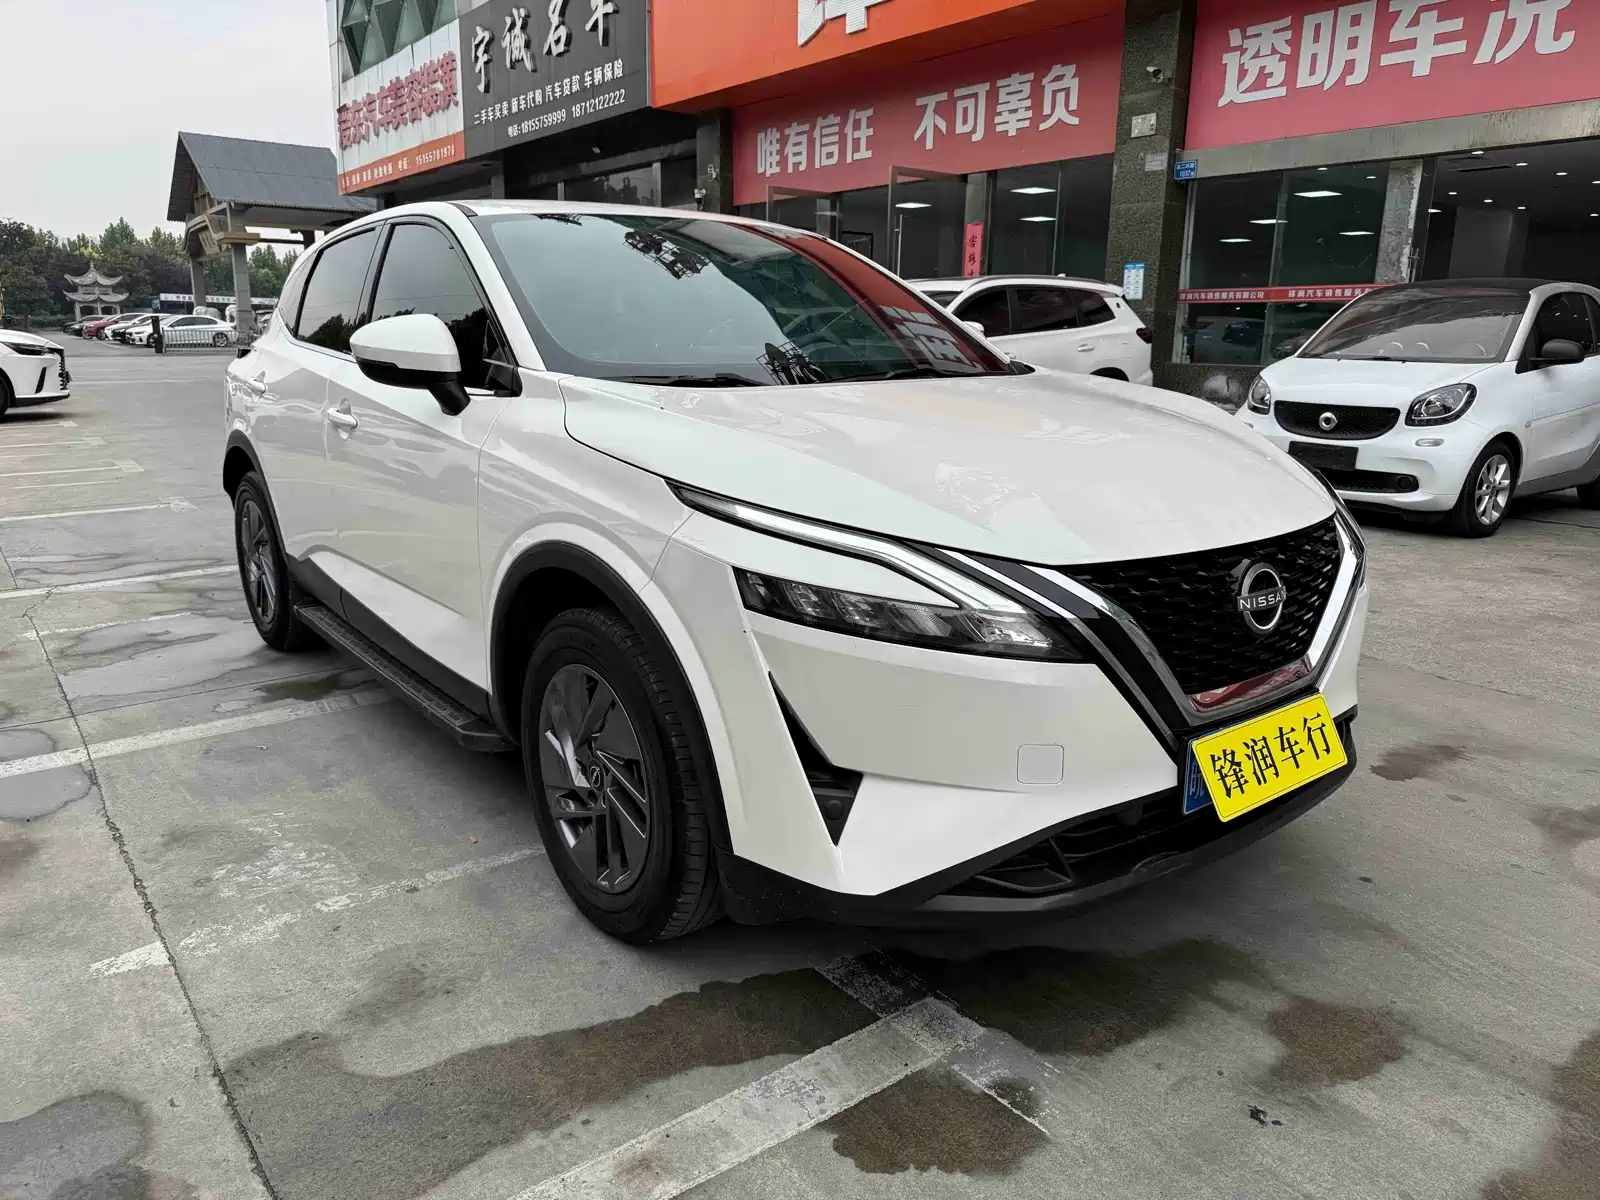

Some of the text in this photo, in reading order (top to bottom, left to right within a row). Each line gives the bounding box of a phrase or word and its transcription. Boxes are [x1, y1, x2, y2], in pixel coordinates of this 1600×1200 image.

[1218, 0, 1576, 107] 透明车况
[474, 58, 623, 125] 二手车买卖 新车代购 汽车贷款 车辆保险
[572, 88, 625, 118] 18712122222
[756, 64, 1080, 178] 唯有信任 不可辜负
[1240, 591, 1287, 610] NISSAN
